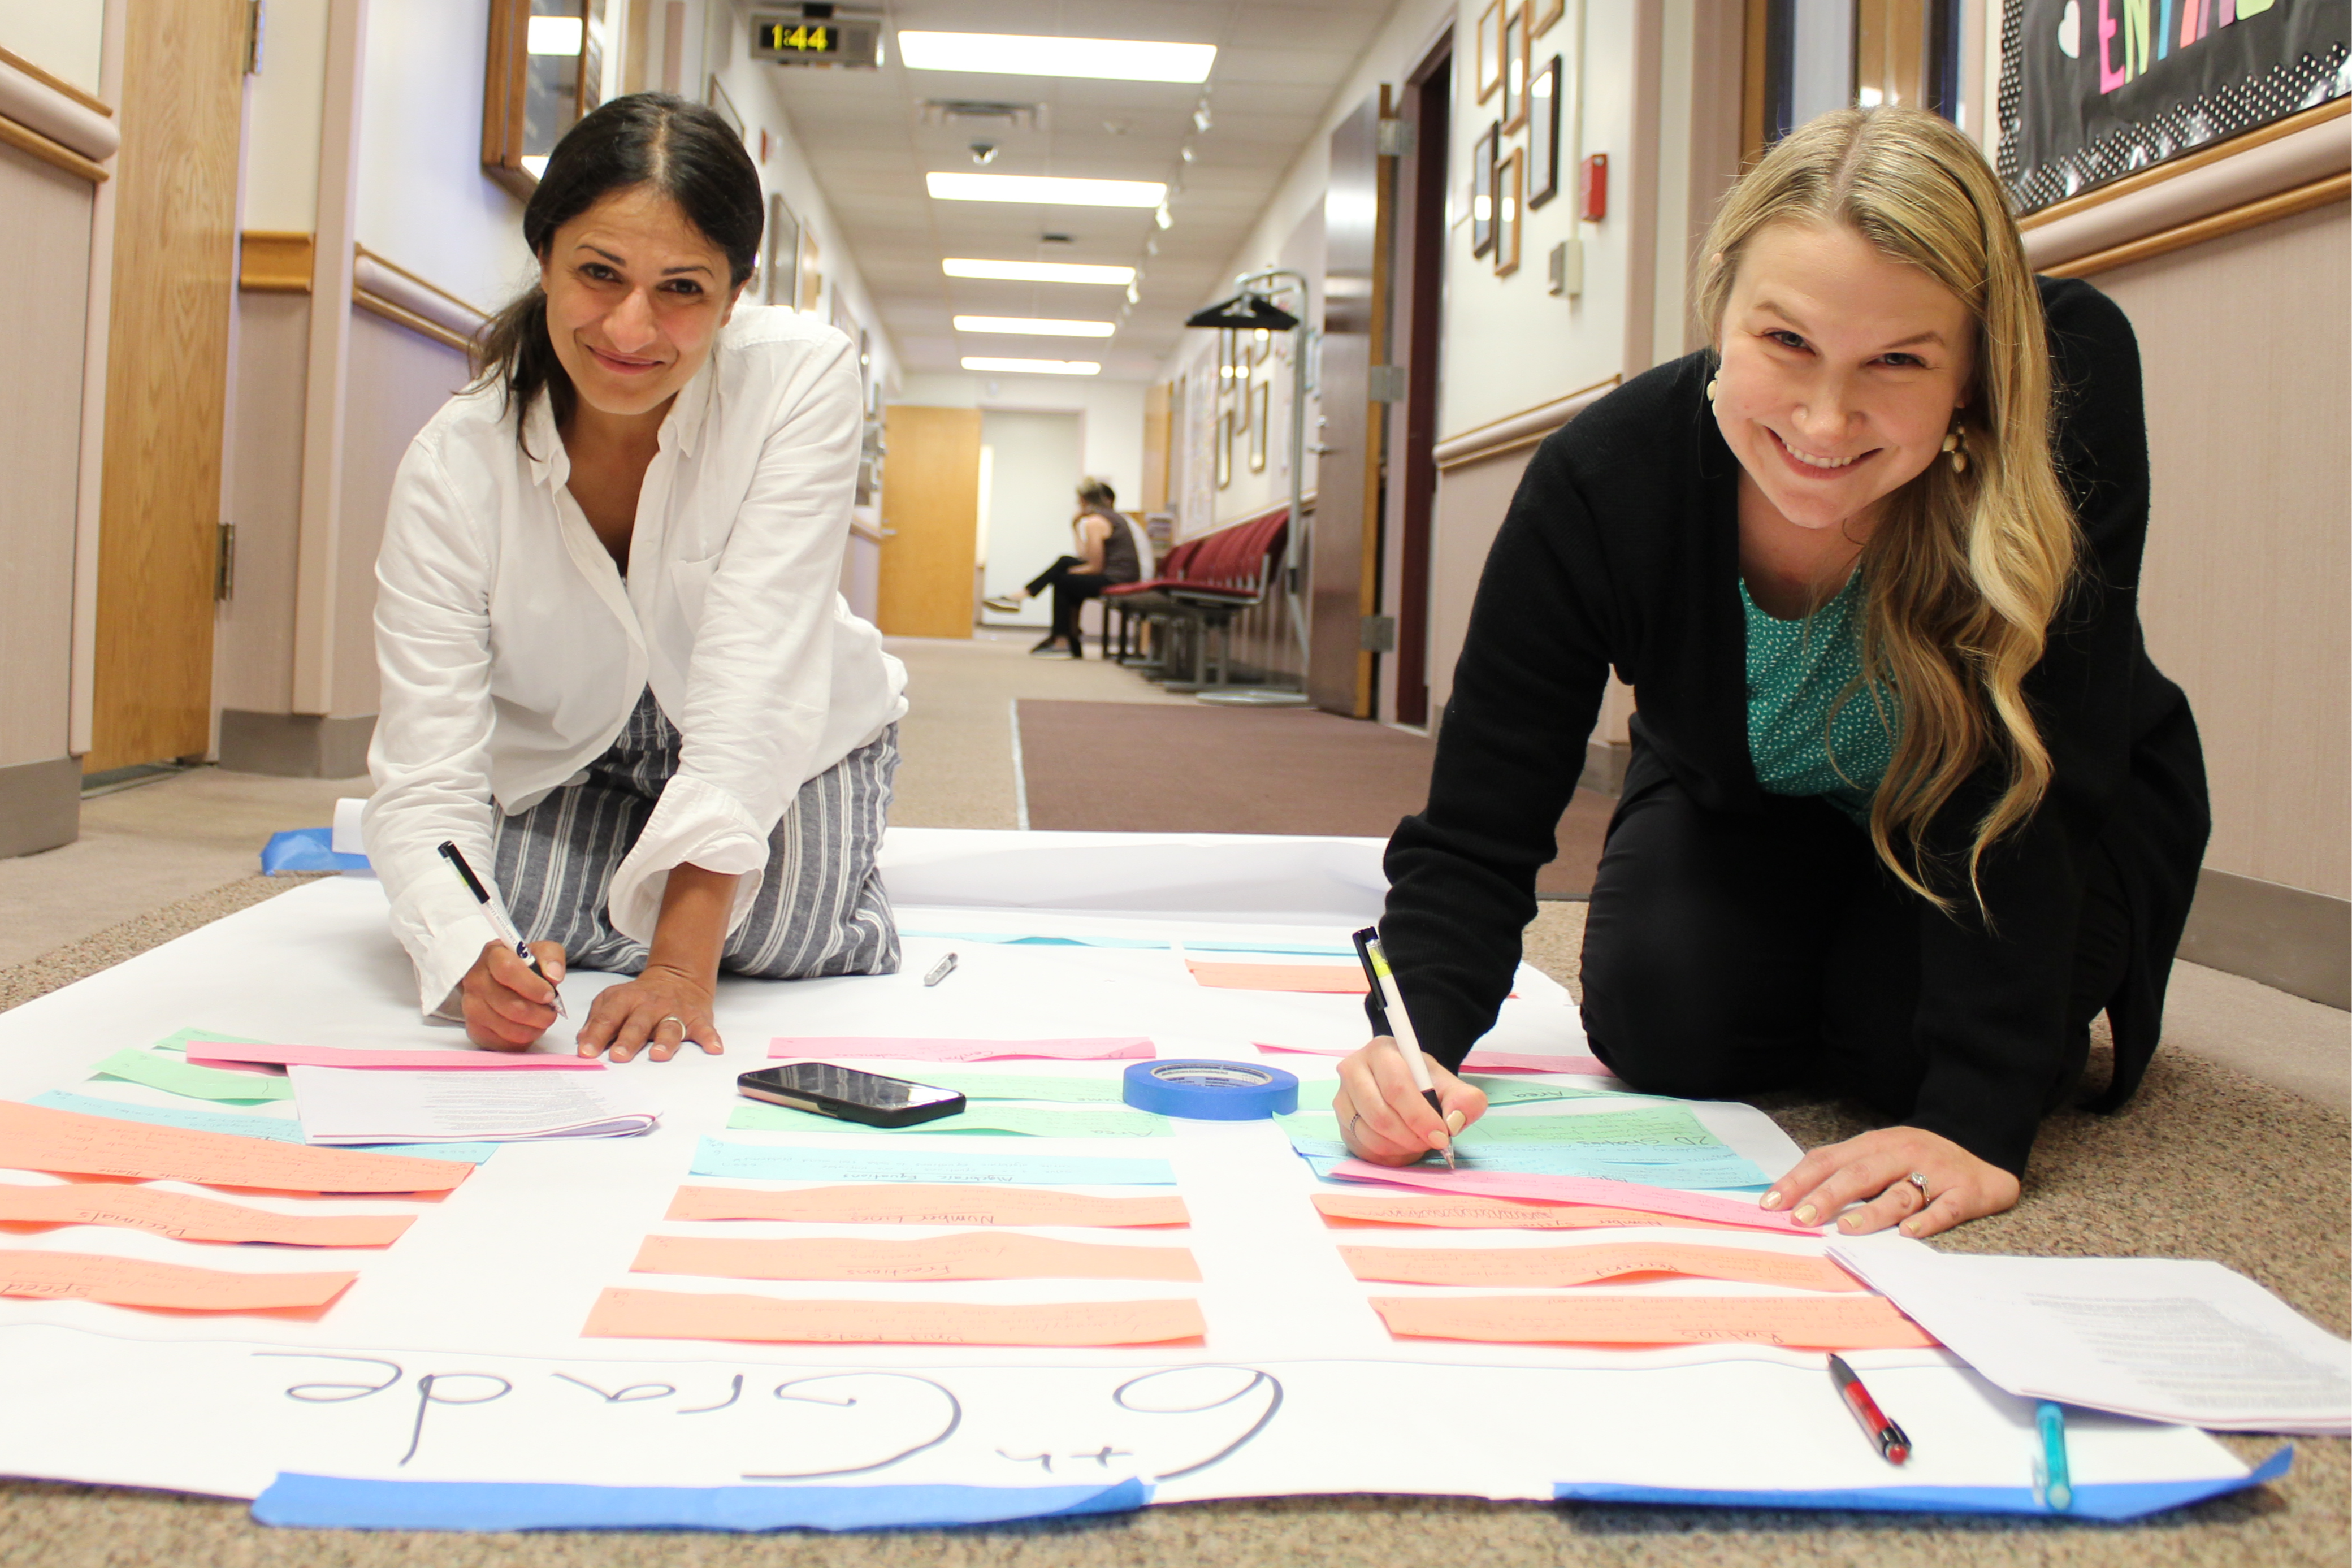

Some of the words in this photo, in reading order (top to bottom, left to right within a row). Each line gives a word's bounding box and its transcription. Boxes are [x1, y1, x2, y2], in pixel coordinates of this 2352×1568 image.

[772, 23, 829, 53] 1:44
[937, 1051, 994, 1063] Central
[1575, 1137, 1661, 1146] Shapes
[1674, 1136, 1709, 1146] 2D
[97, 1168, 142, 1177] Plane
[937, 1174, 1013, 1183] Algebraic
[158, 1173, 248, 1185] Coordinate
[75, 1211, 187, 1237] Decimals
[851, 1215, 904, 1224] Lines
[916, 1215, 994, 1225] Number
[846, 1265, 951, 1277] Fractions
[1594, 1262, 1680, 1278] Percent
[0, 1283, 92, 1298] Speed
[806, 1333, 883, 1342] Rates
[1680, 1331, 1784, 1345] Ratios
[251, 1352, 961, 1482] Grade
[995, 1365, 1284, 1483] 6th
